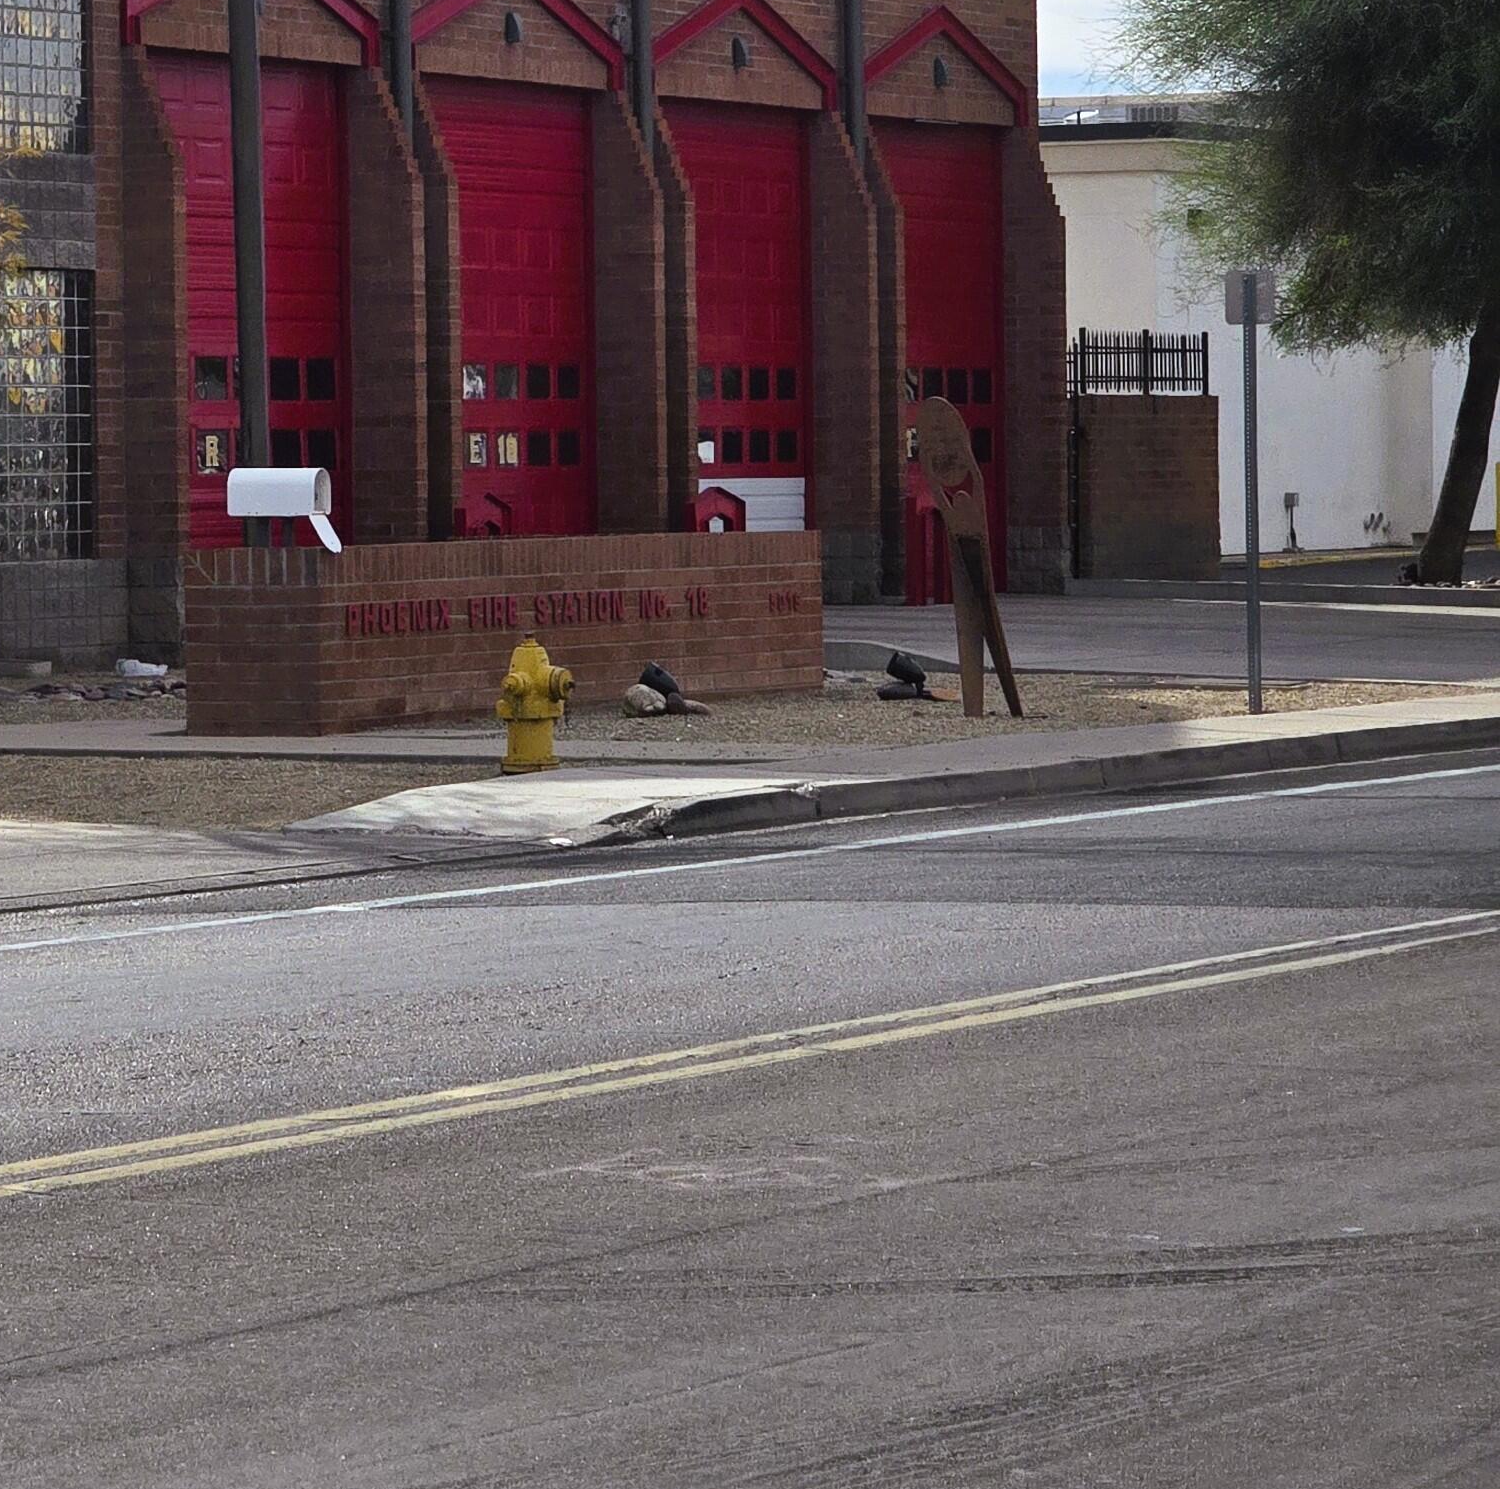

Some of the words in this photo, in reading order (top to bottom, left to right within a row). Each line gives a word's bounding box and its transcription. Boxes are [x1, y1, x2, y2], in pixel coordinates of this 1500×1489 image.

[469, 432, 483, 464] E
[346, 598, 450, 638] PHOENIX
[468, 593, 518, 629] FIRE
[535, 590, 626, 626] STATION
[684, 586, 708, 617] 18
